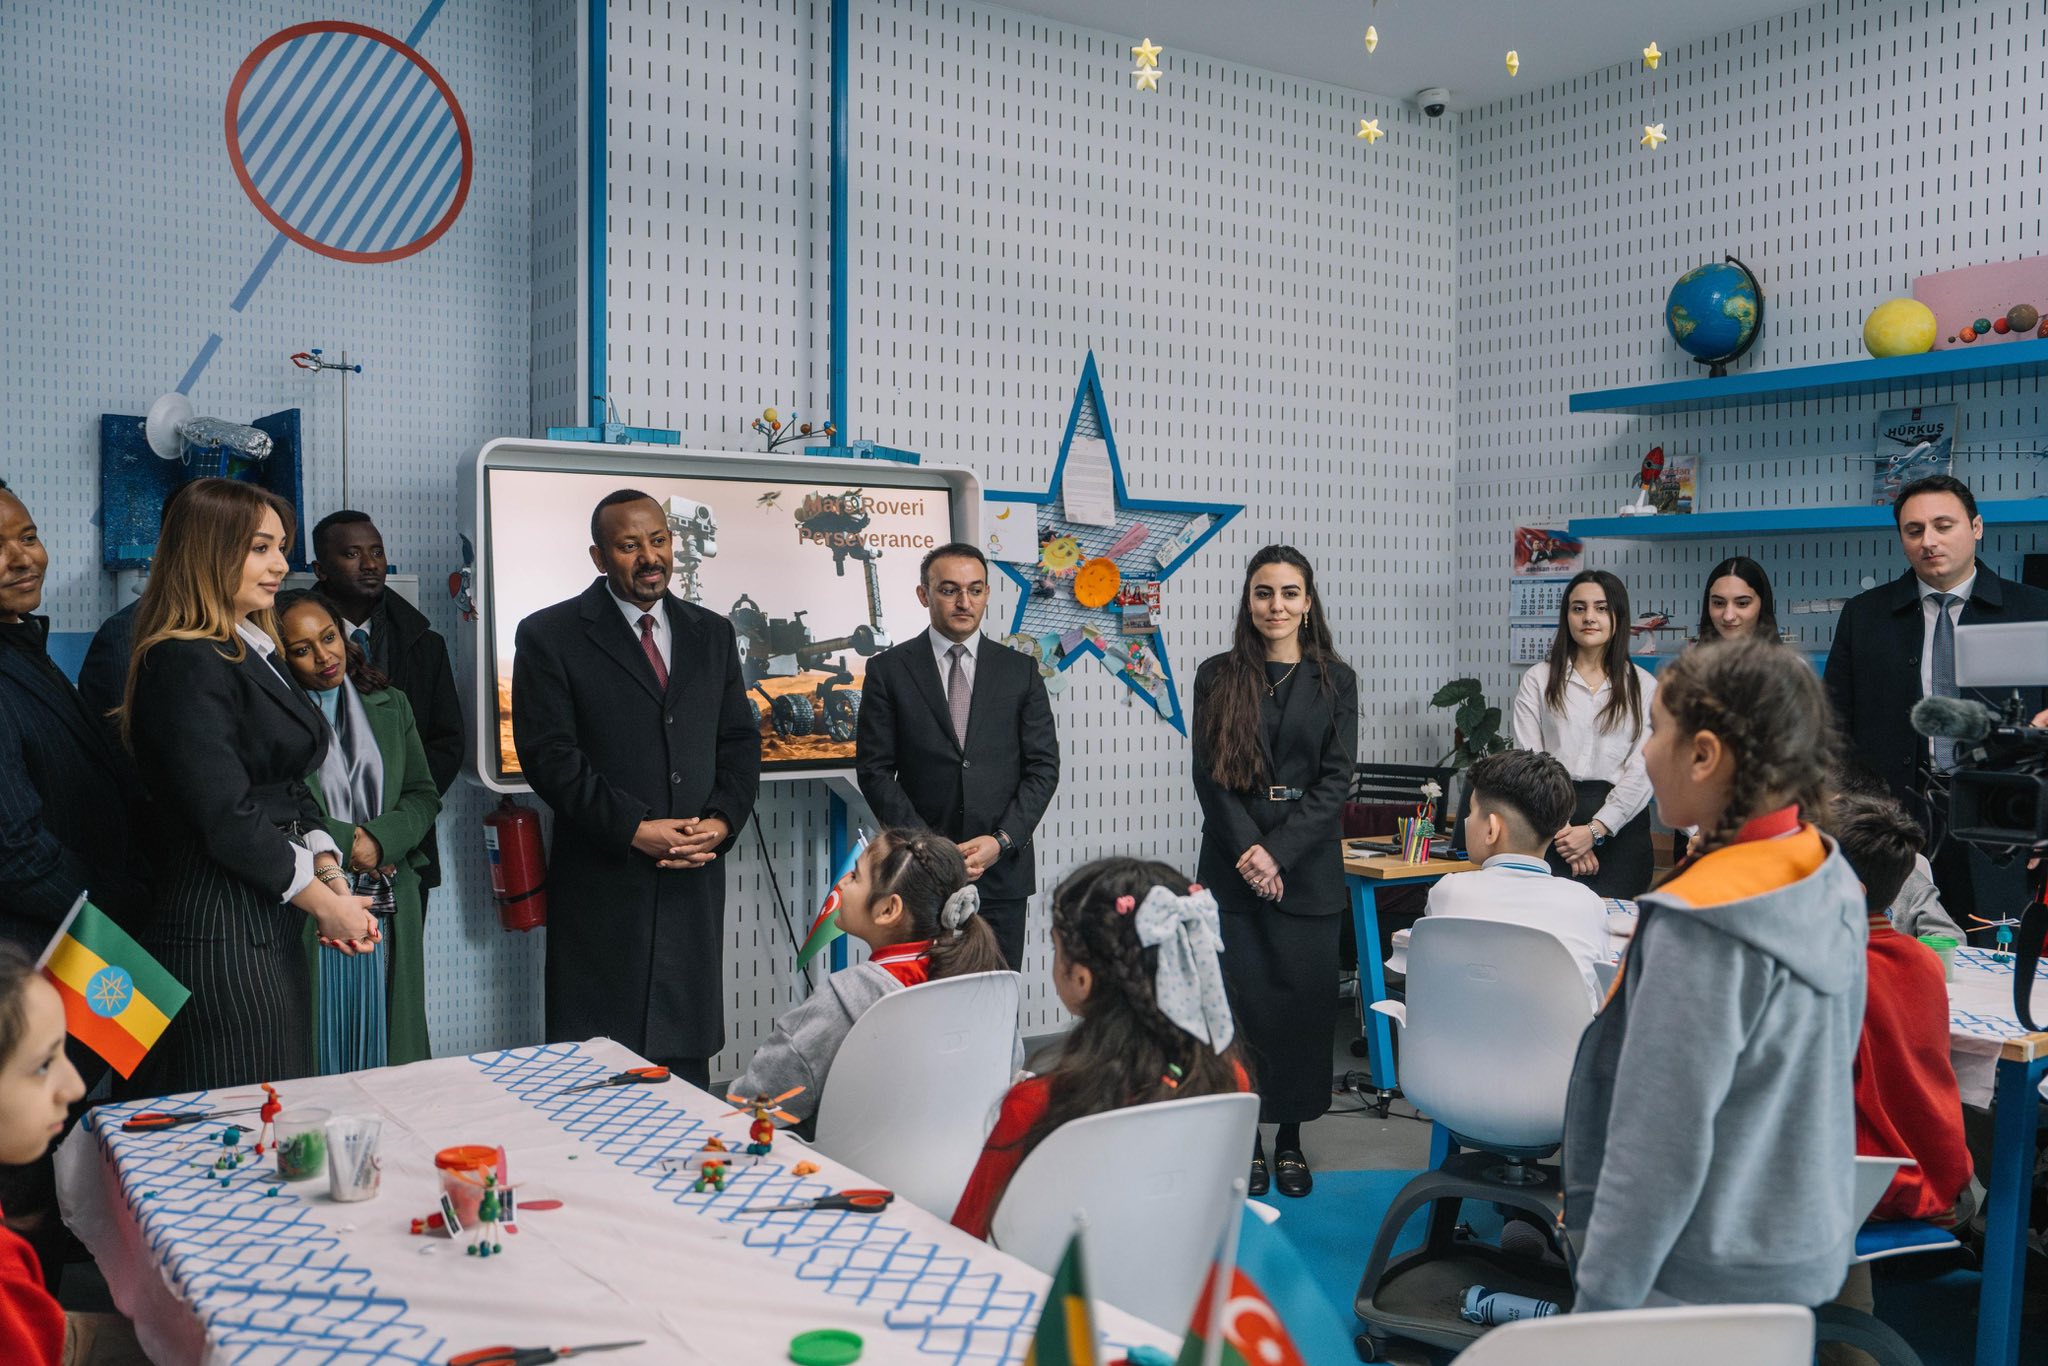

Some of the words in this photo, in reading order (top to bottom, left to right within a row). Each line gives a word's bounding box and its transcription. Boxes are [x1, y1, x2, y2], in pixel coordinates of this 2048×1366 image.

[804, 495, 853, 514] Mars
[861, 496, 924, 516] Roveri
[798, 527, 934, 549] Perseverance
